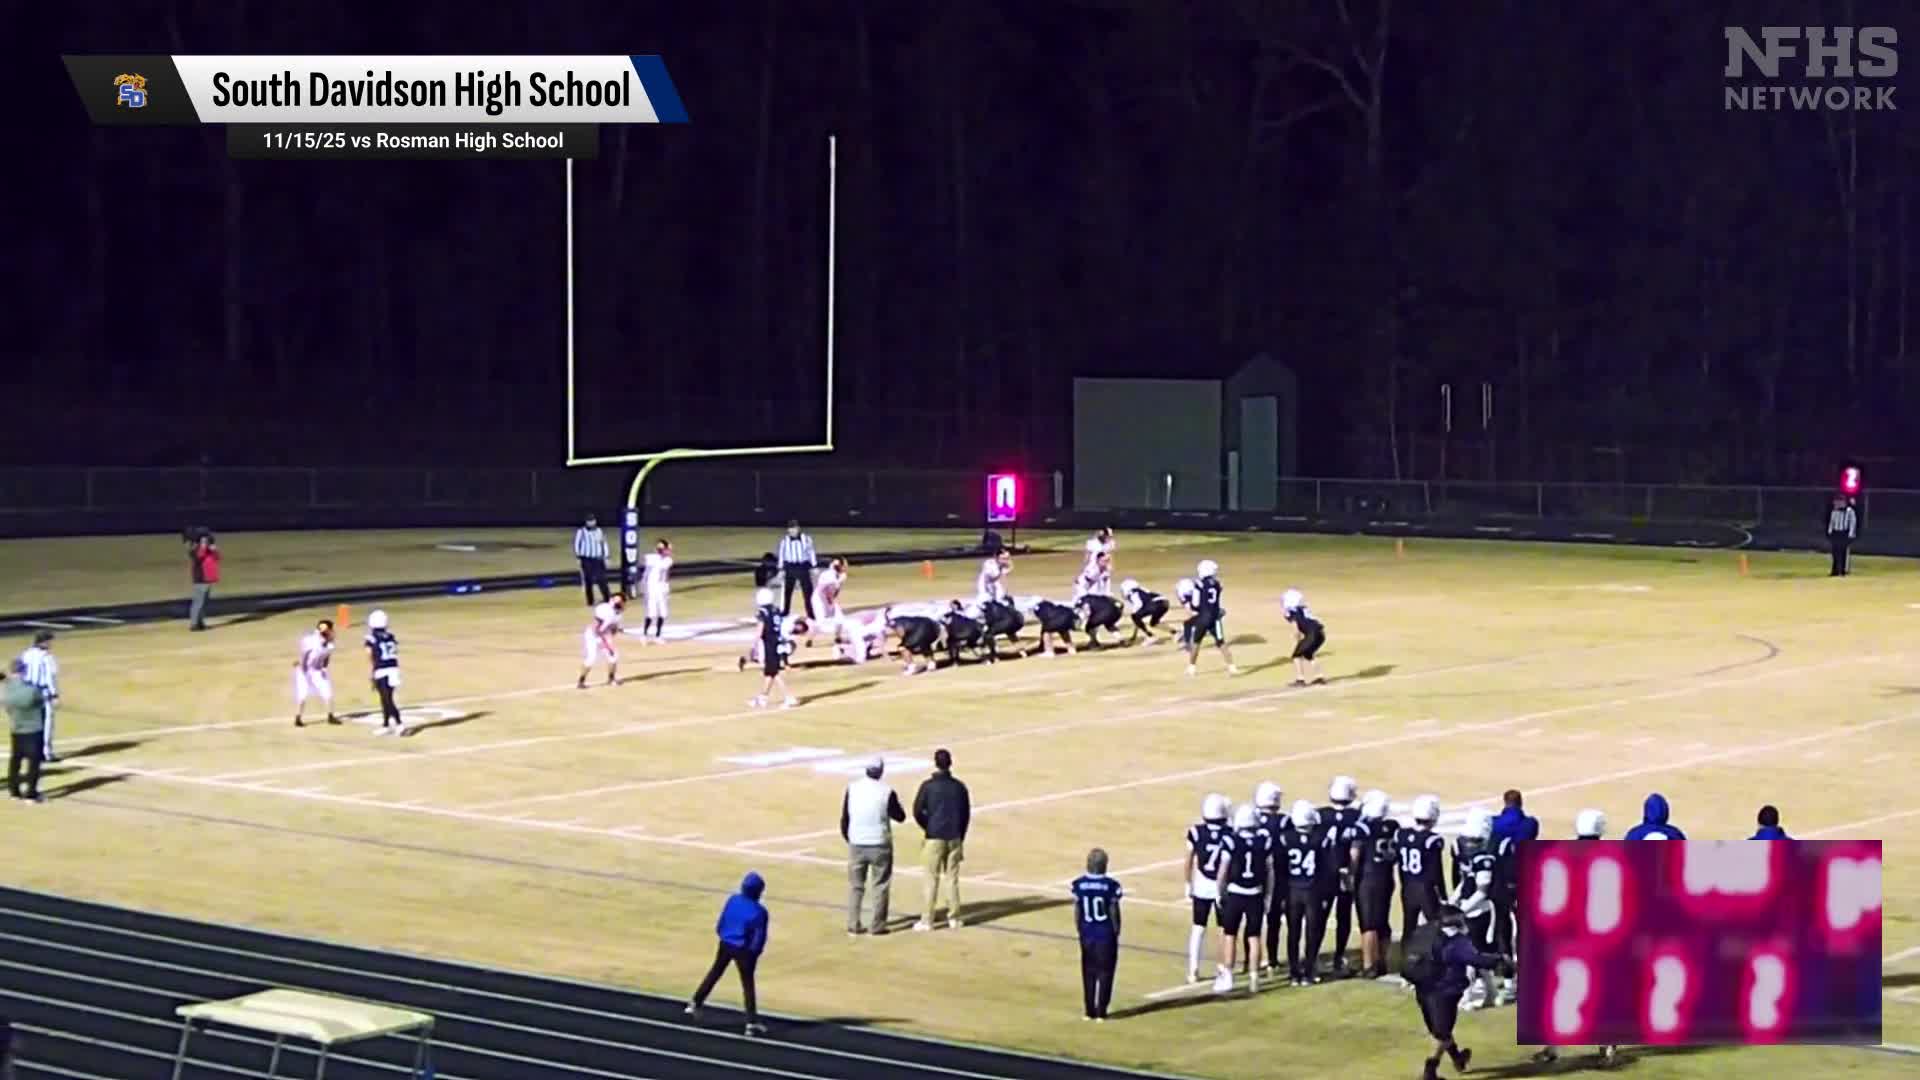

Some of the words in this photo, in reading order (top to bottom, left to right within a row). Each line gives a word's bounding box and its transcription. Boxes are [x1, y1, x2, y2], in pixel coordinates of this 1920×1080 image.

[1207, 587, 1217, 604] 3
[1203, 843, 1222, 872] 7
[1241, 851, 1255, 879] 1
[1287, 847, 1316, 877] 24
[1400, 846, 1423, 876] 18
